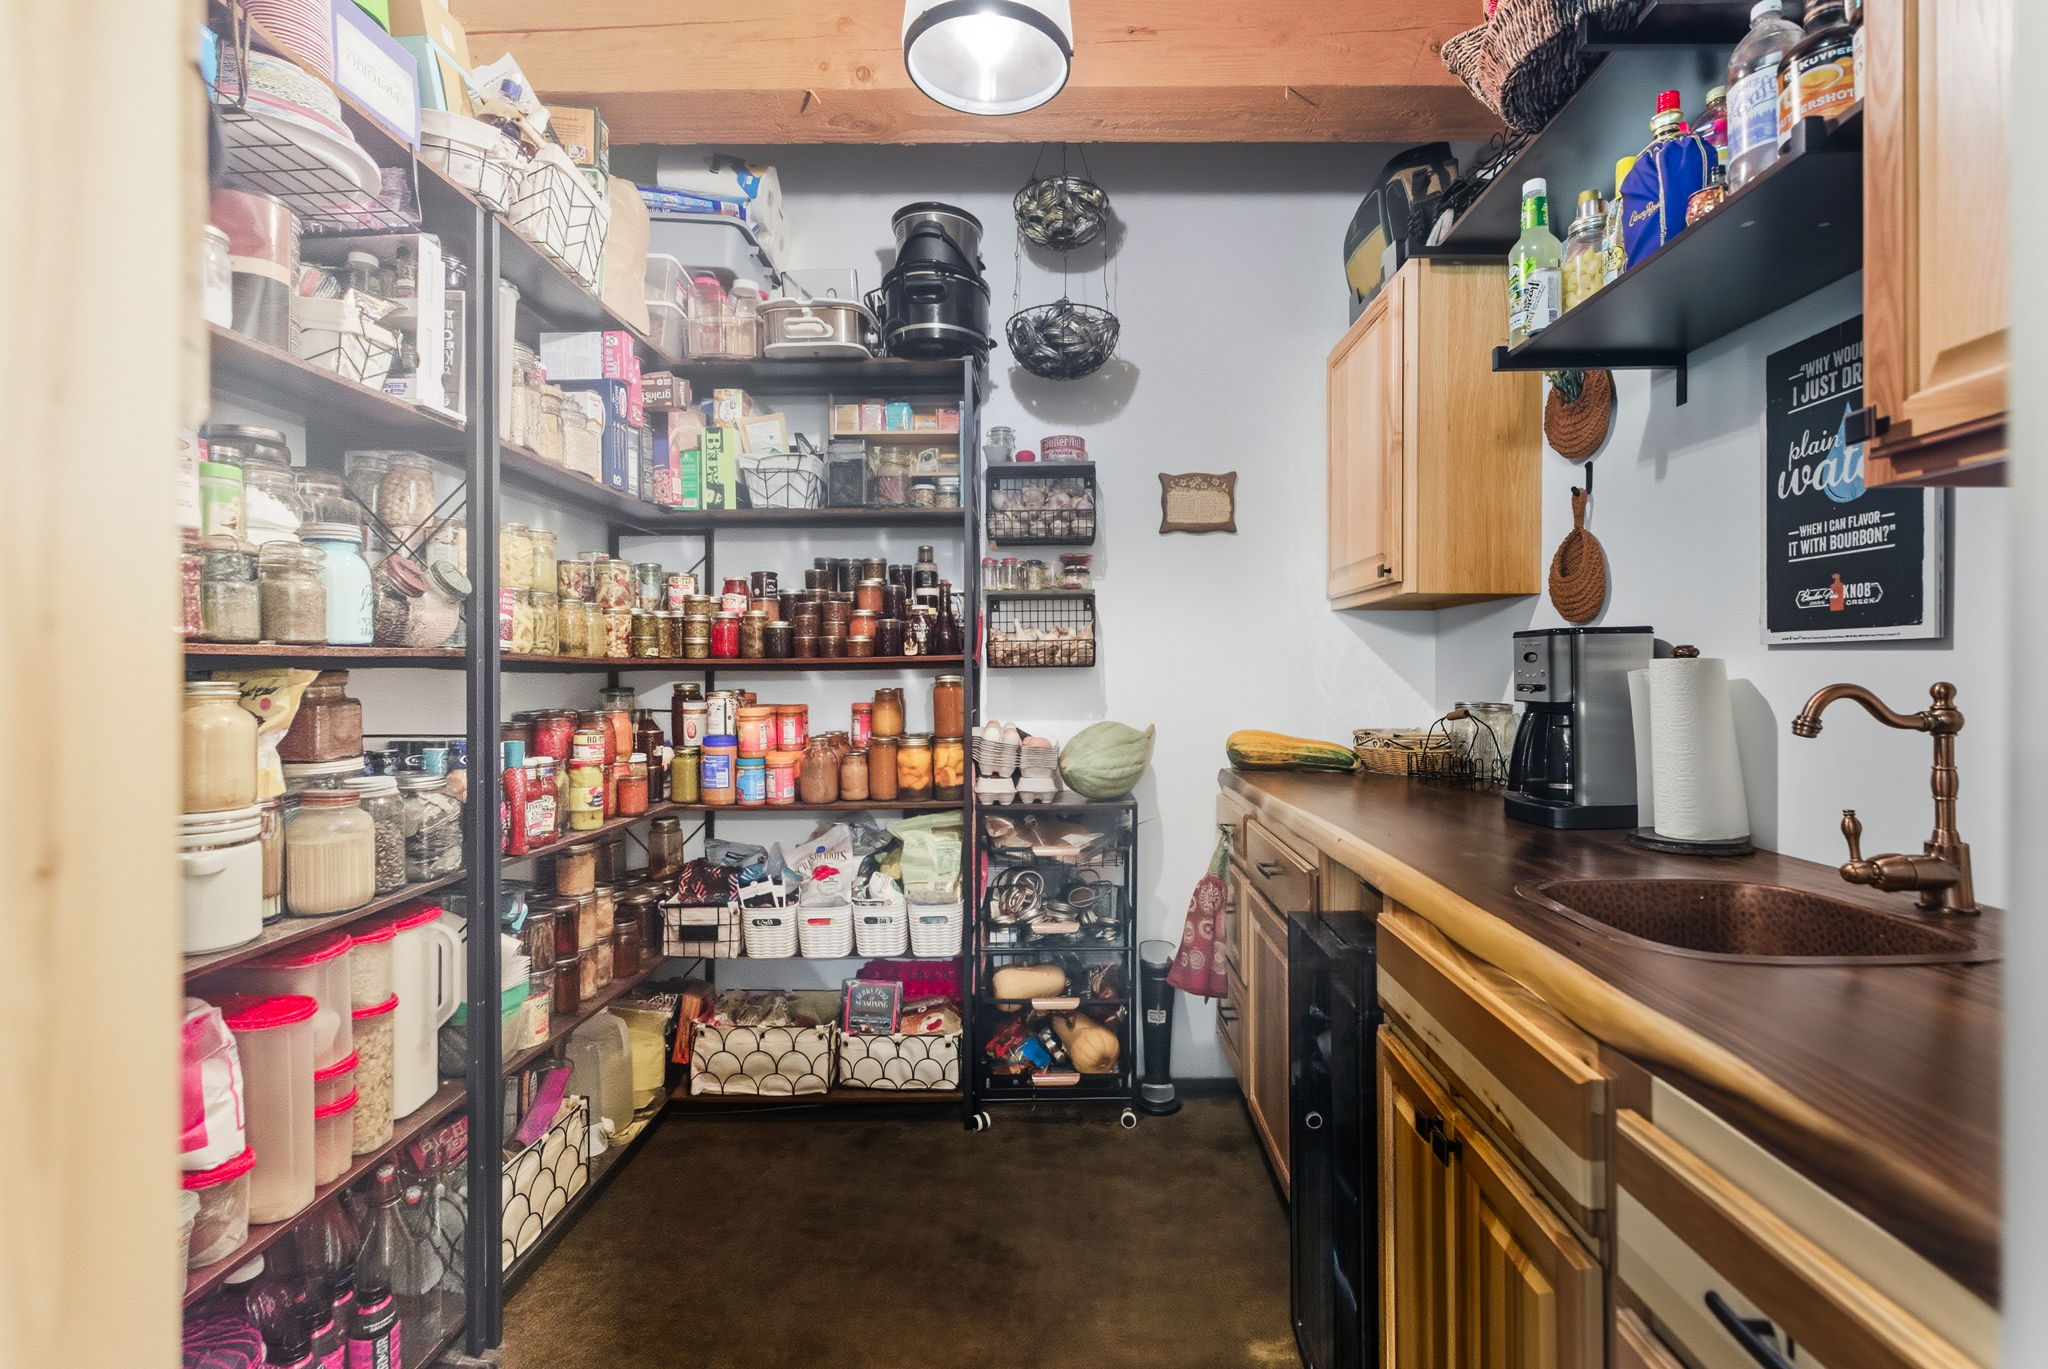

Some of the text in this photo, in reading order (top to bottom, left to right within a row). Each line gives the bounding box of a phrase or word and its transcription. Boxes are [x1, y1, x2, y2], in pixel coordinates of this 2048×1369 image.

[1793, 362, 1863, 407] I JUST DR
[1788, 429, 1841, 471] plain
[1799, 510, 1881, 537] WHEN I CAN FLAVOR
[1788, 523, 1896, 557] IT WITH BOURBON?"
[1843, 582, 1871, 600] KNOB
[1845, 598, 1876, 606] CREEK
